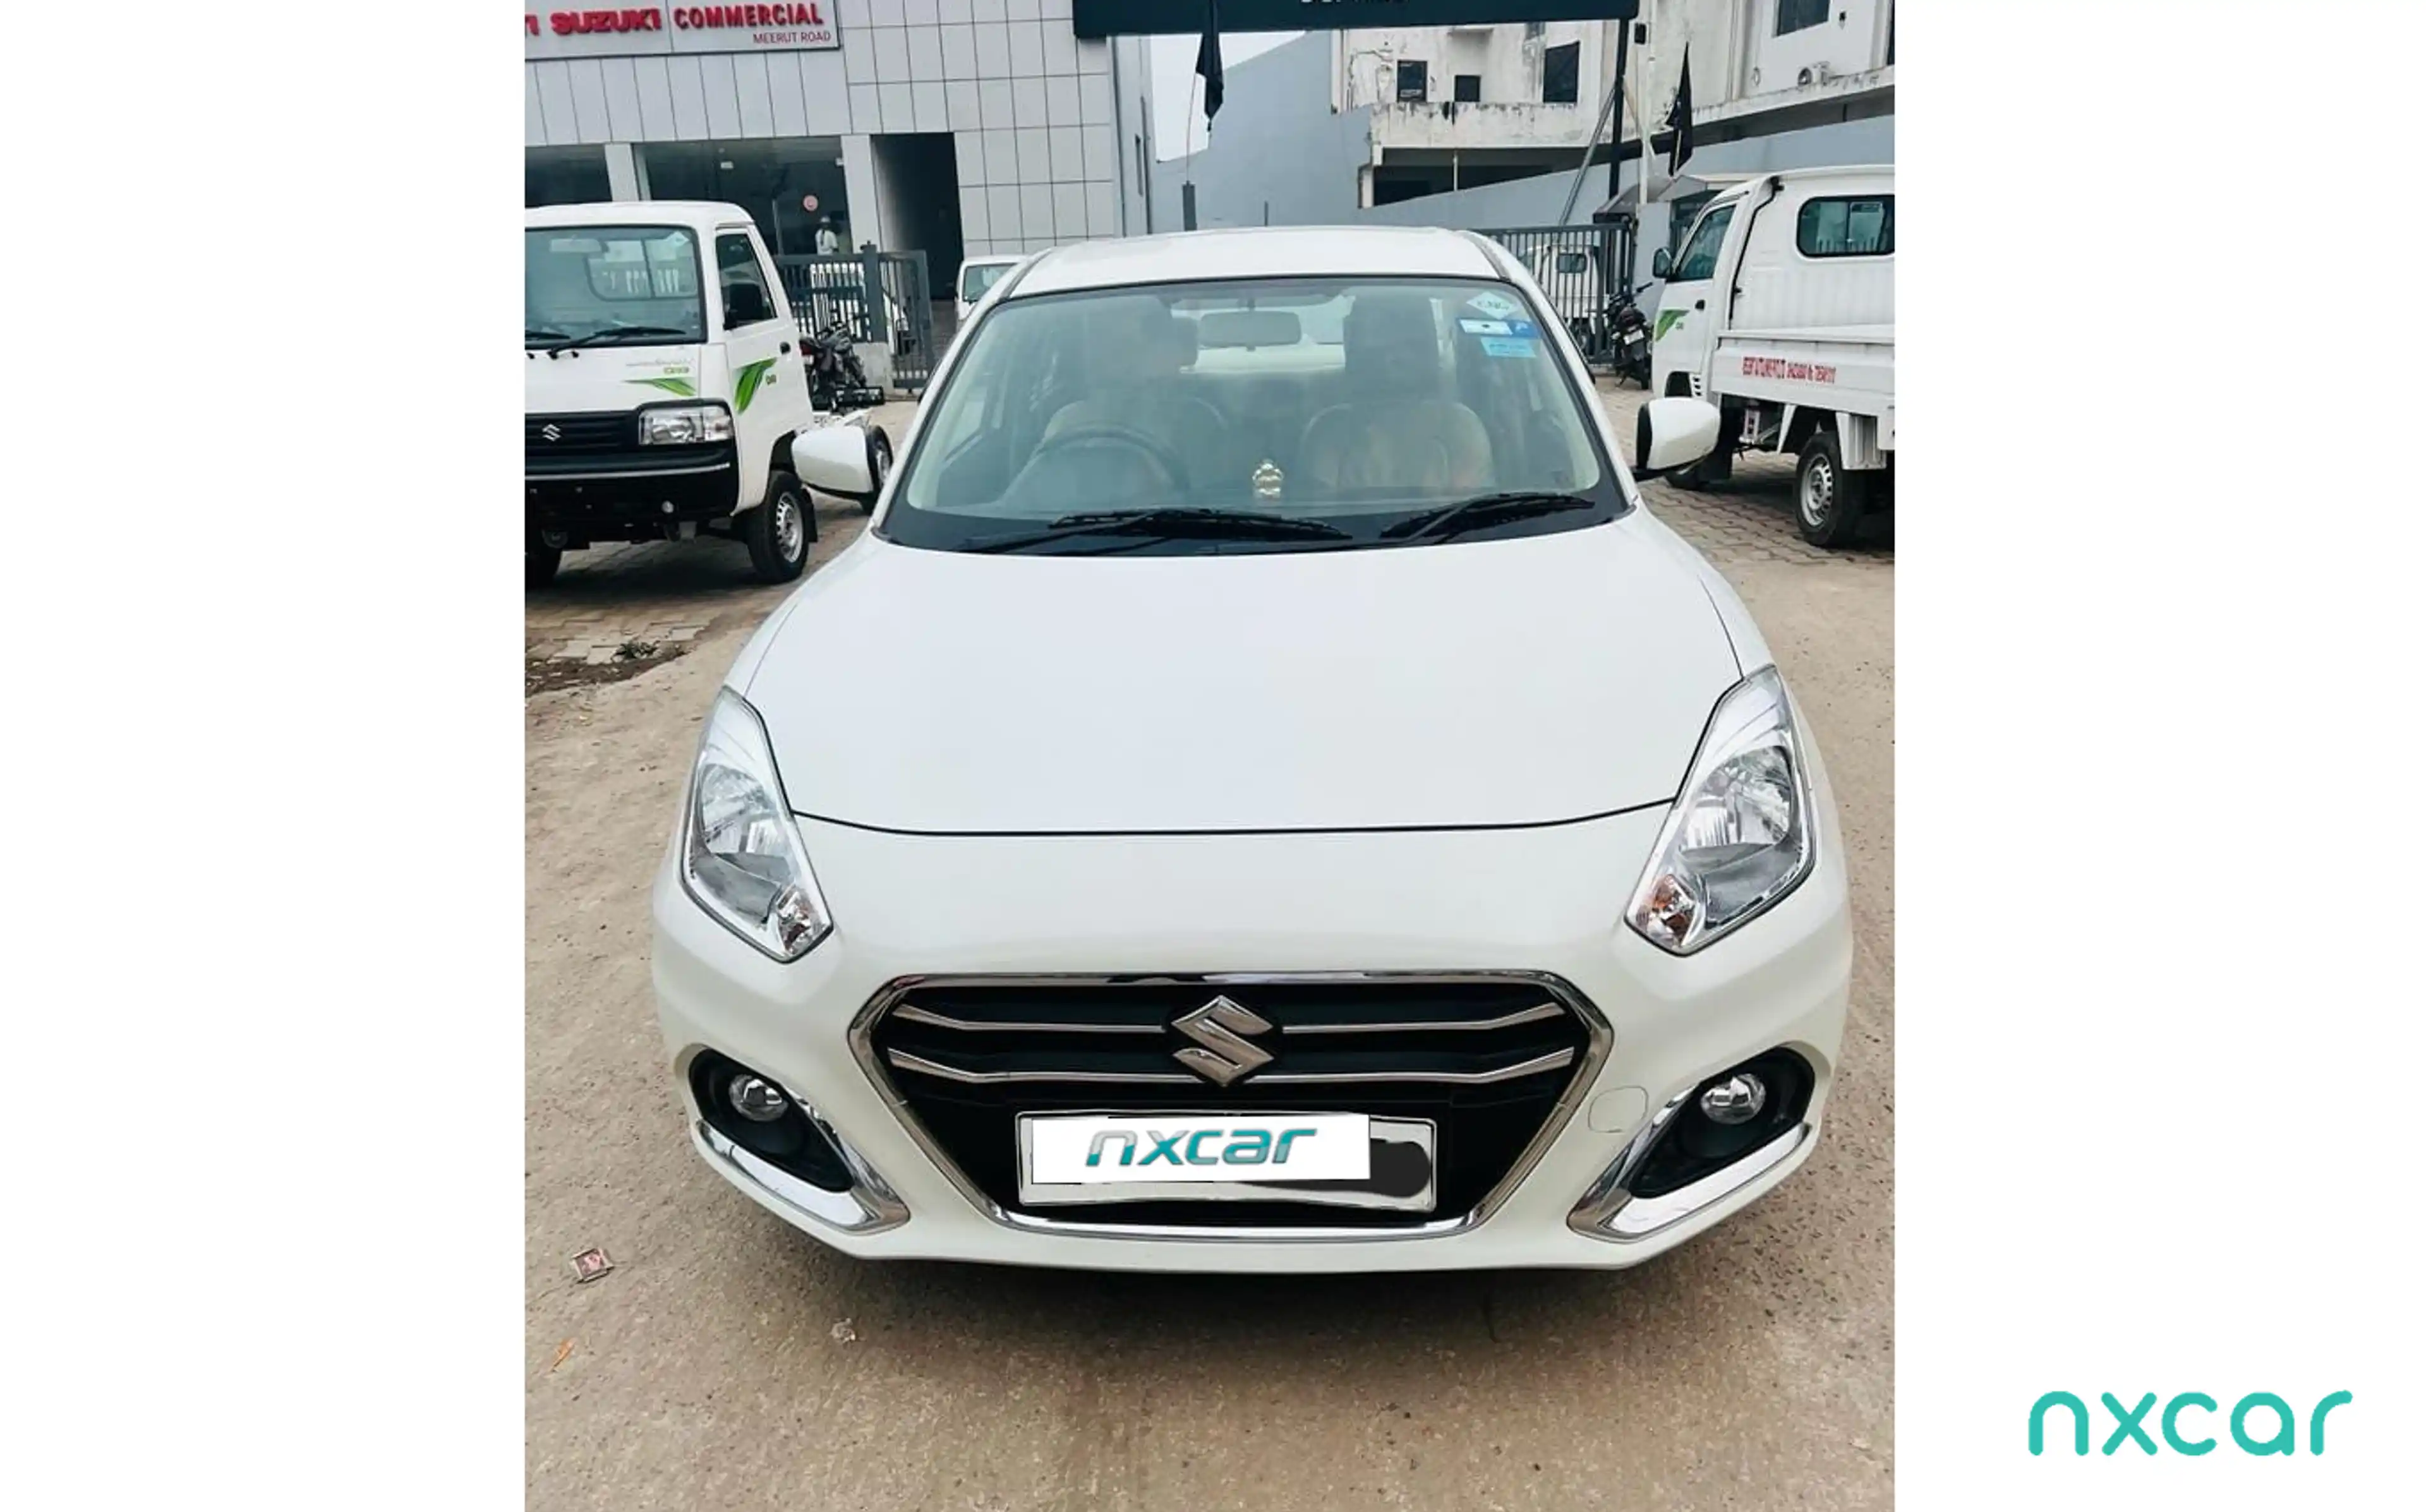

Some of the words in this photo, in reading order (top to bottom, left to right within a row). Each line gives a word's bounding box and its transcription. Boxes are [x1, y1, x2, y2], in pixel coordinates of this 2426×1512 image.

[550, 8, 662, 35] SUZUKI
[673, 3, 824, 30] COMMERCIAL
[752, 32, 797, 44] MEERUT
[800, 32, 831, 42] ROAD
